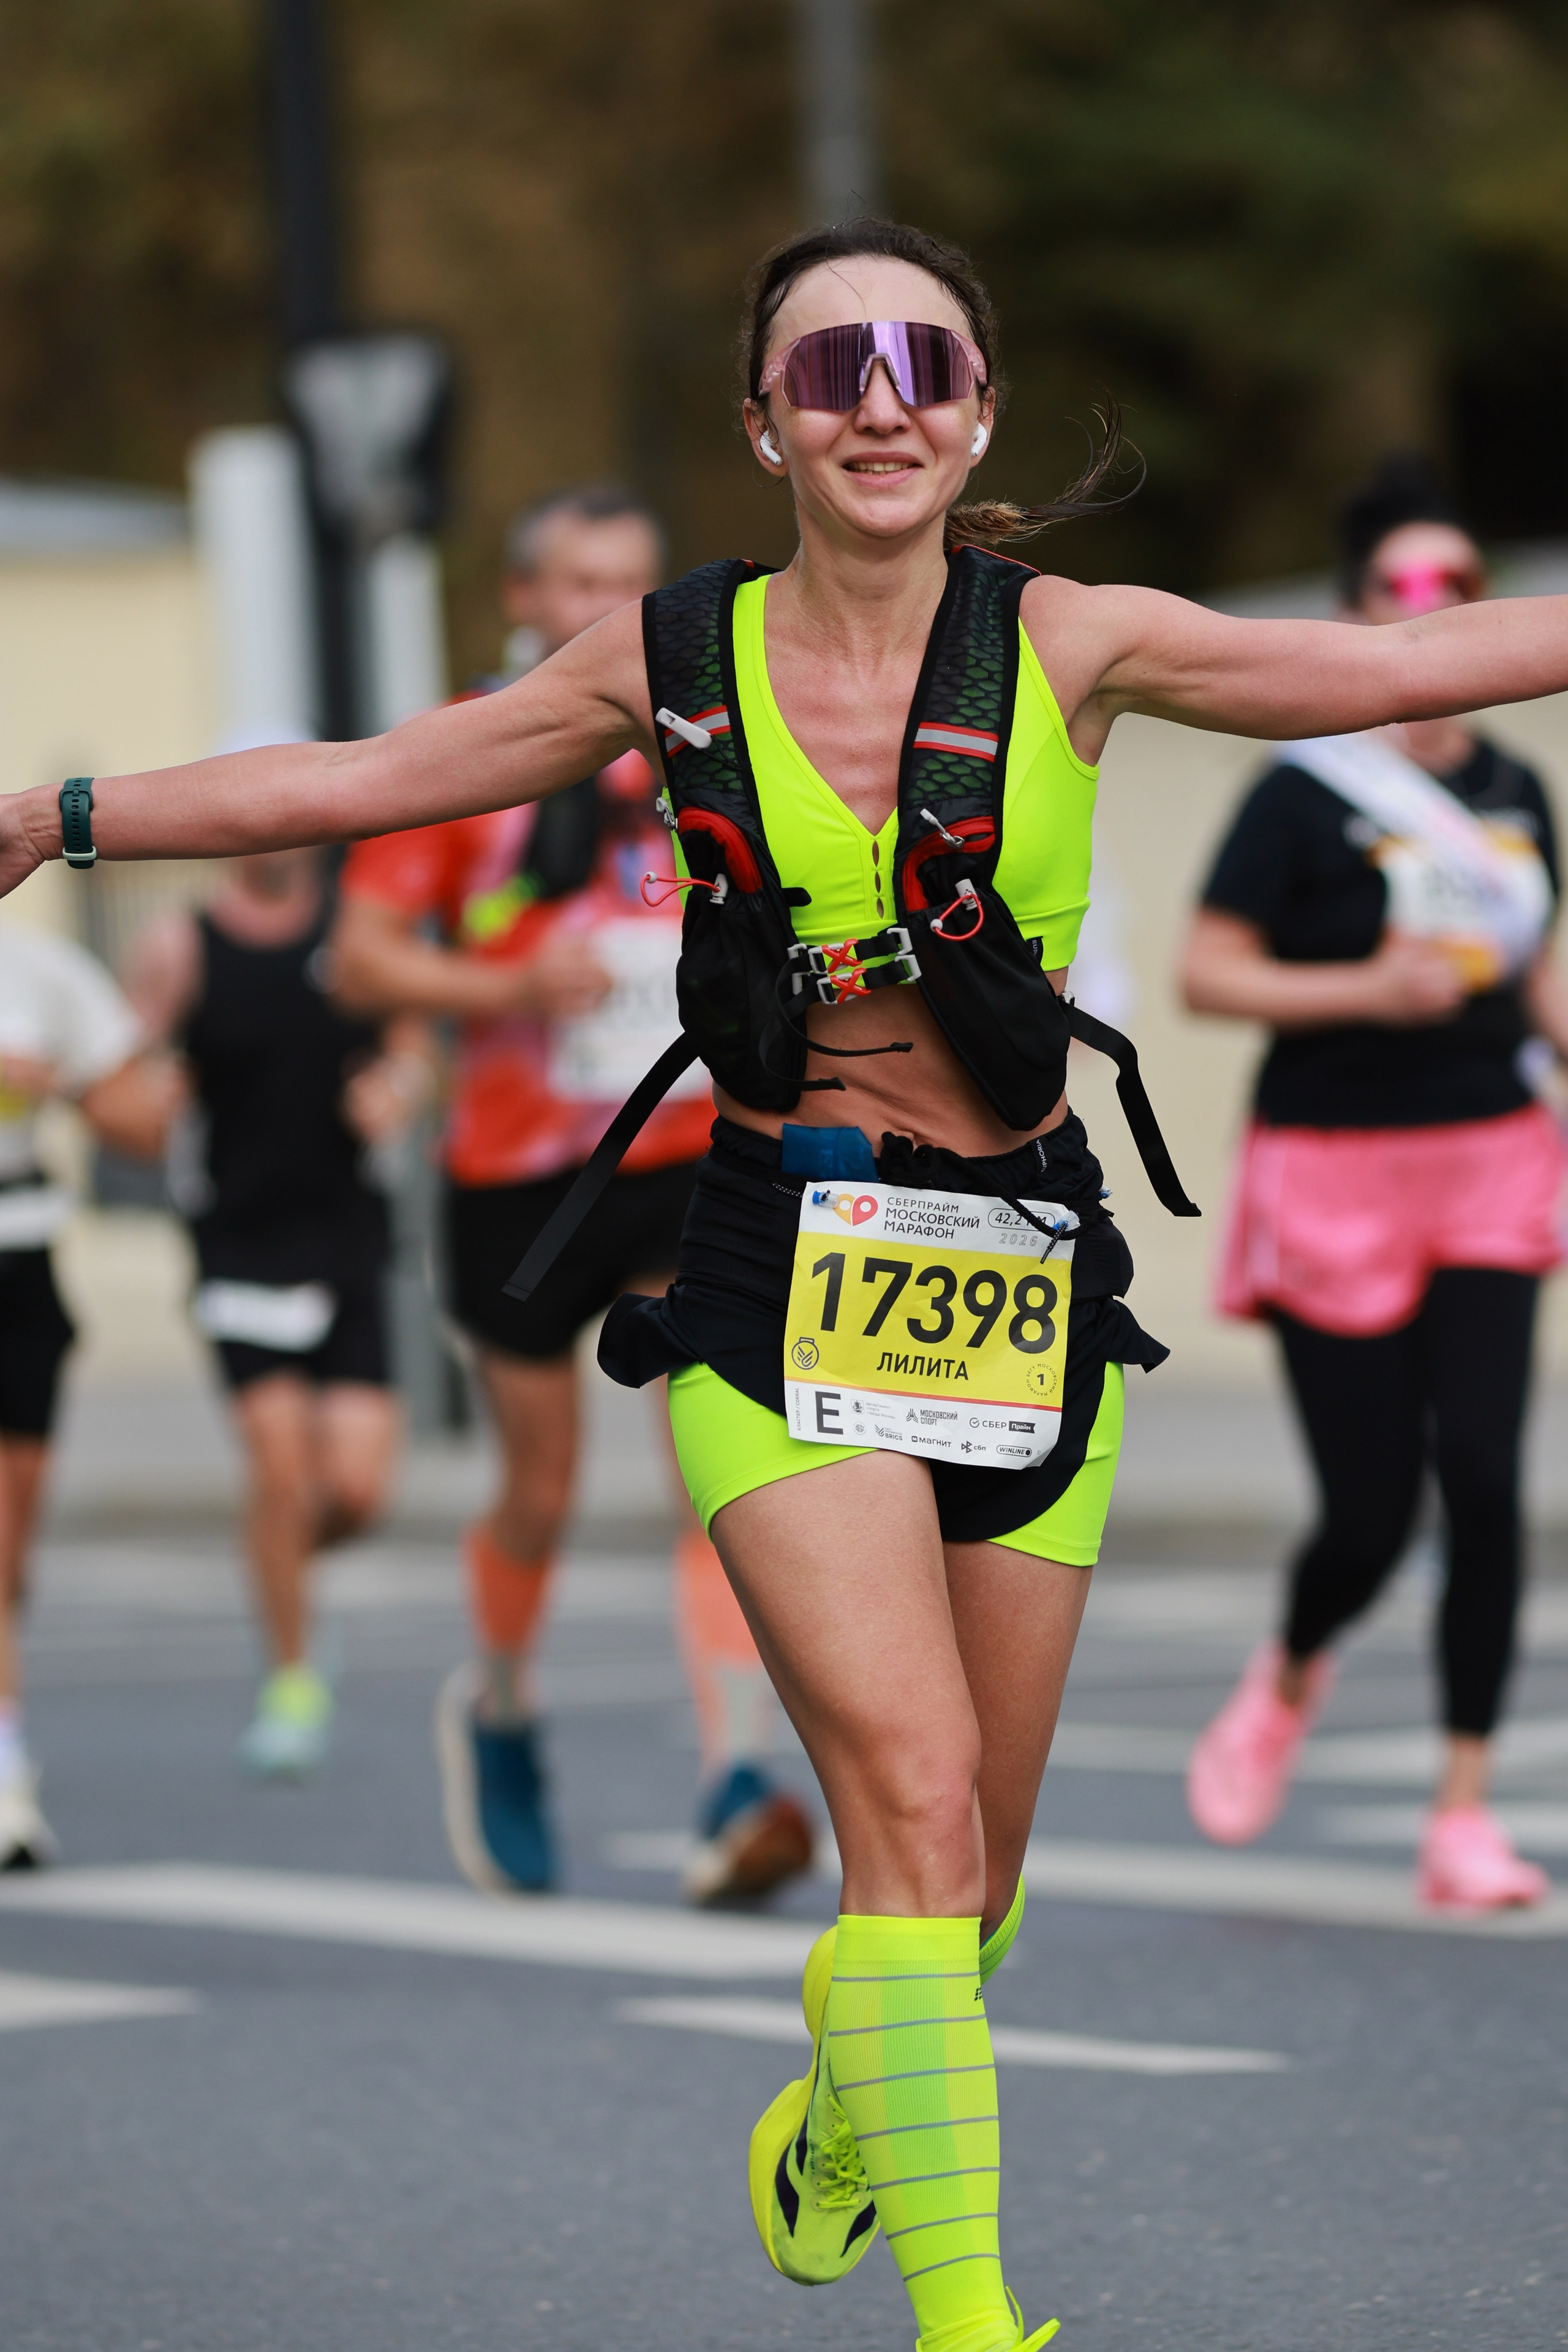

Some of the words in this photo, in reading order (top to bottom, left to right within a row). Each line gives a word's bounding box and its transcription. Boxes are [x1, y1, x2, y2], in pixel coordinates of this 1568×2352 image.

[887, 1197, 959, 1213] СБЕРПРАЙМ
[886, 1207, 980, 1228] МОСКОВСКИЙ
[995, 1212, 1022, 1226] 42,2
[884, 1220, 955, 1238] МАРАФОН
[999, 1233, 1038, 1246] 2026
[811, 1252, 1058, 1354] 17398
[876, 1352, 969, 1381] ЛИЛИТА
[1037, 1373, 1044, 1385] 1
[920, 1409, 958, 1420] МОСКОВСКИЙ
[921, 1417, 937, 1426] СПОРТ
[982, 1420, 1007, 1428] СБЕР
